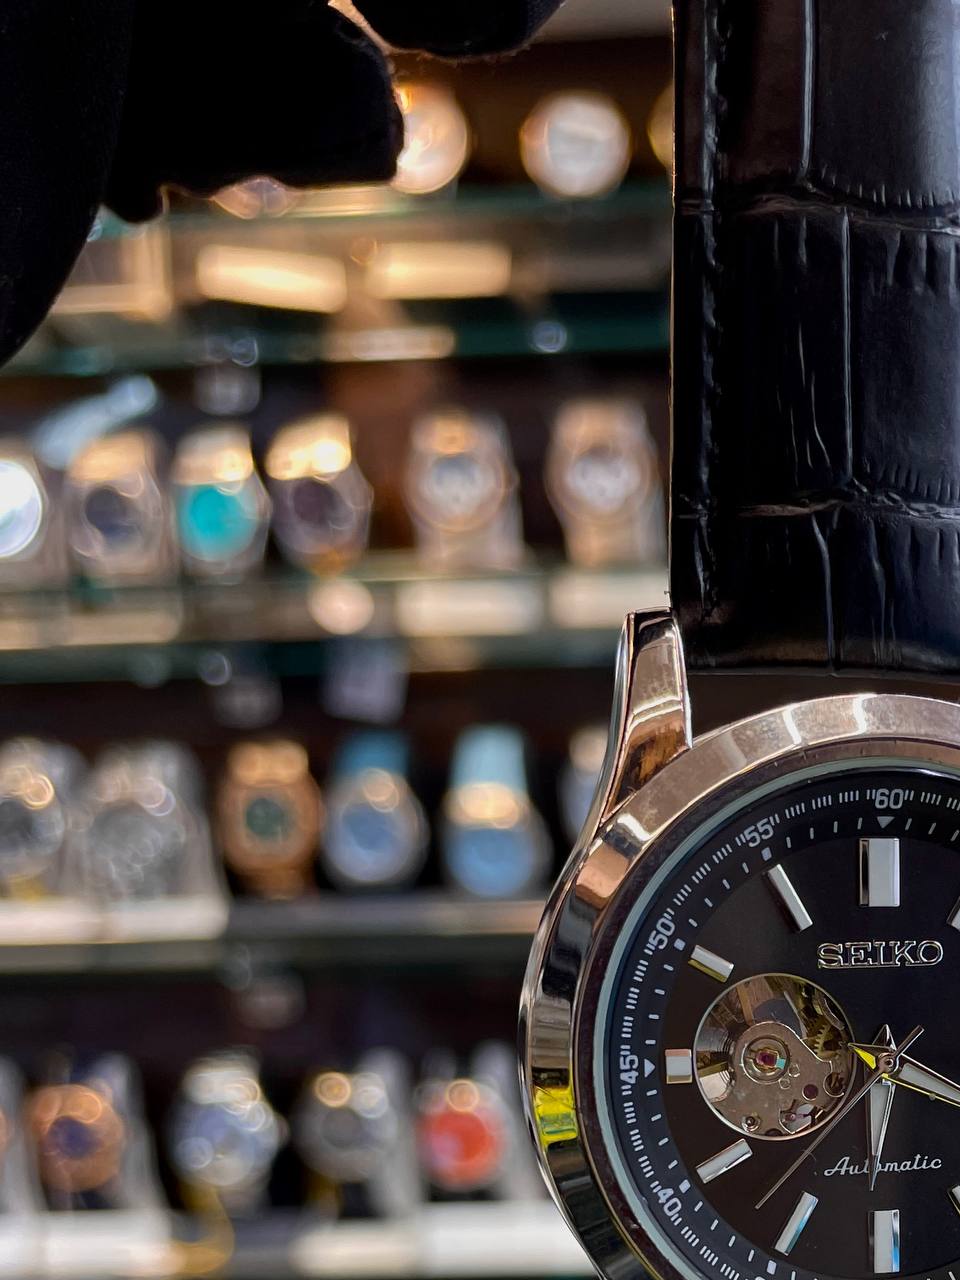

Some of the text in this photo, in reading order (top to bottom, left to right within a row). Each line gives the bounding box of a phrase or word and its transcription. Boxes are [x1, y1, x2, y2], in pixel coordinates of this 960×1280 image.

[874, 788, 904, 809] 60
[746, 819, 775, 848] 55
[651, 916, 676, 950] 50
[817, 940, 944, 969] SEIKO
[620, 1054, 639, 1084] 45
[657, 1187, 682, 1215] 40
